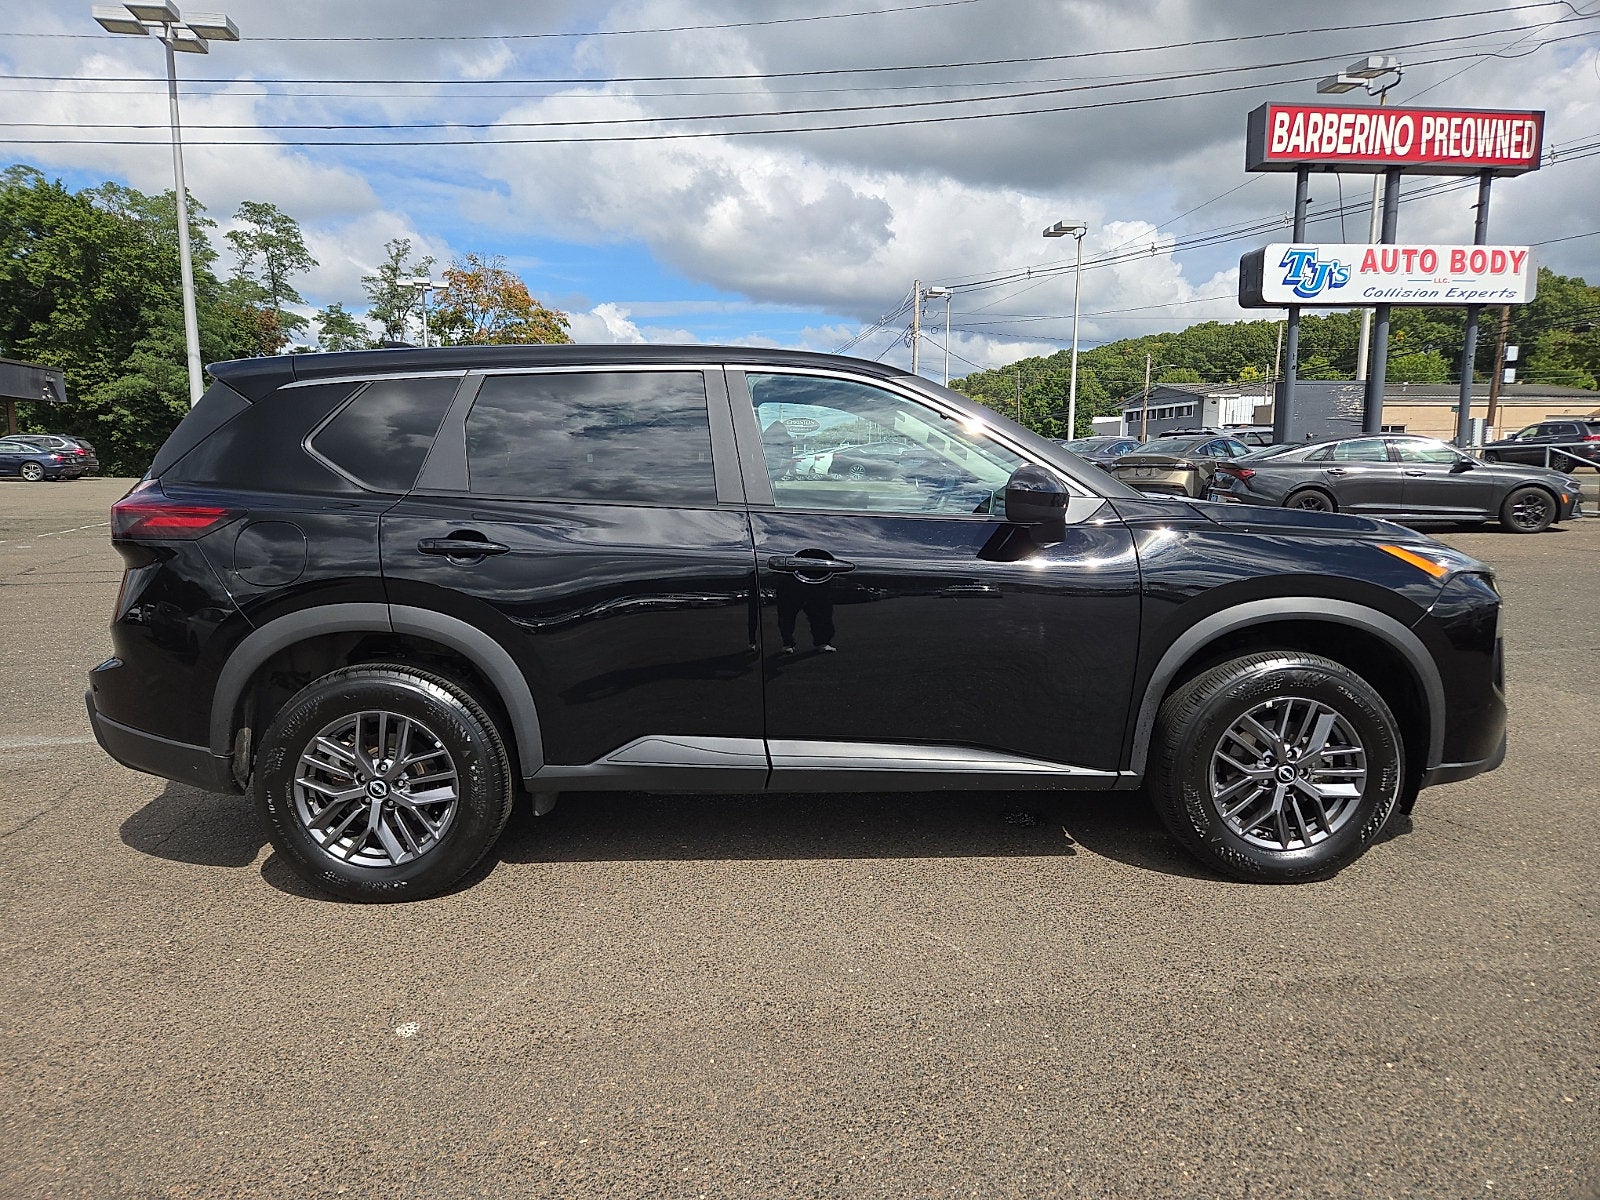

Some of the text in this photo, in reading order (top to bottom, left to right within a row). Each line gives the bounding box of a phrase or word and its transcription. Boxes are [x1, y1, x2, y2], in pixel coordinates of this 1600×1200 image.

[1271, 112, 1537, 159] BARBERINO PREOWNED
[1278, 247, 1352, 298] TJ's
[1360, 248, 1527, 274] AUTO BODY
[1362, 286, 1518, 300] Collision Experts
